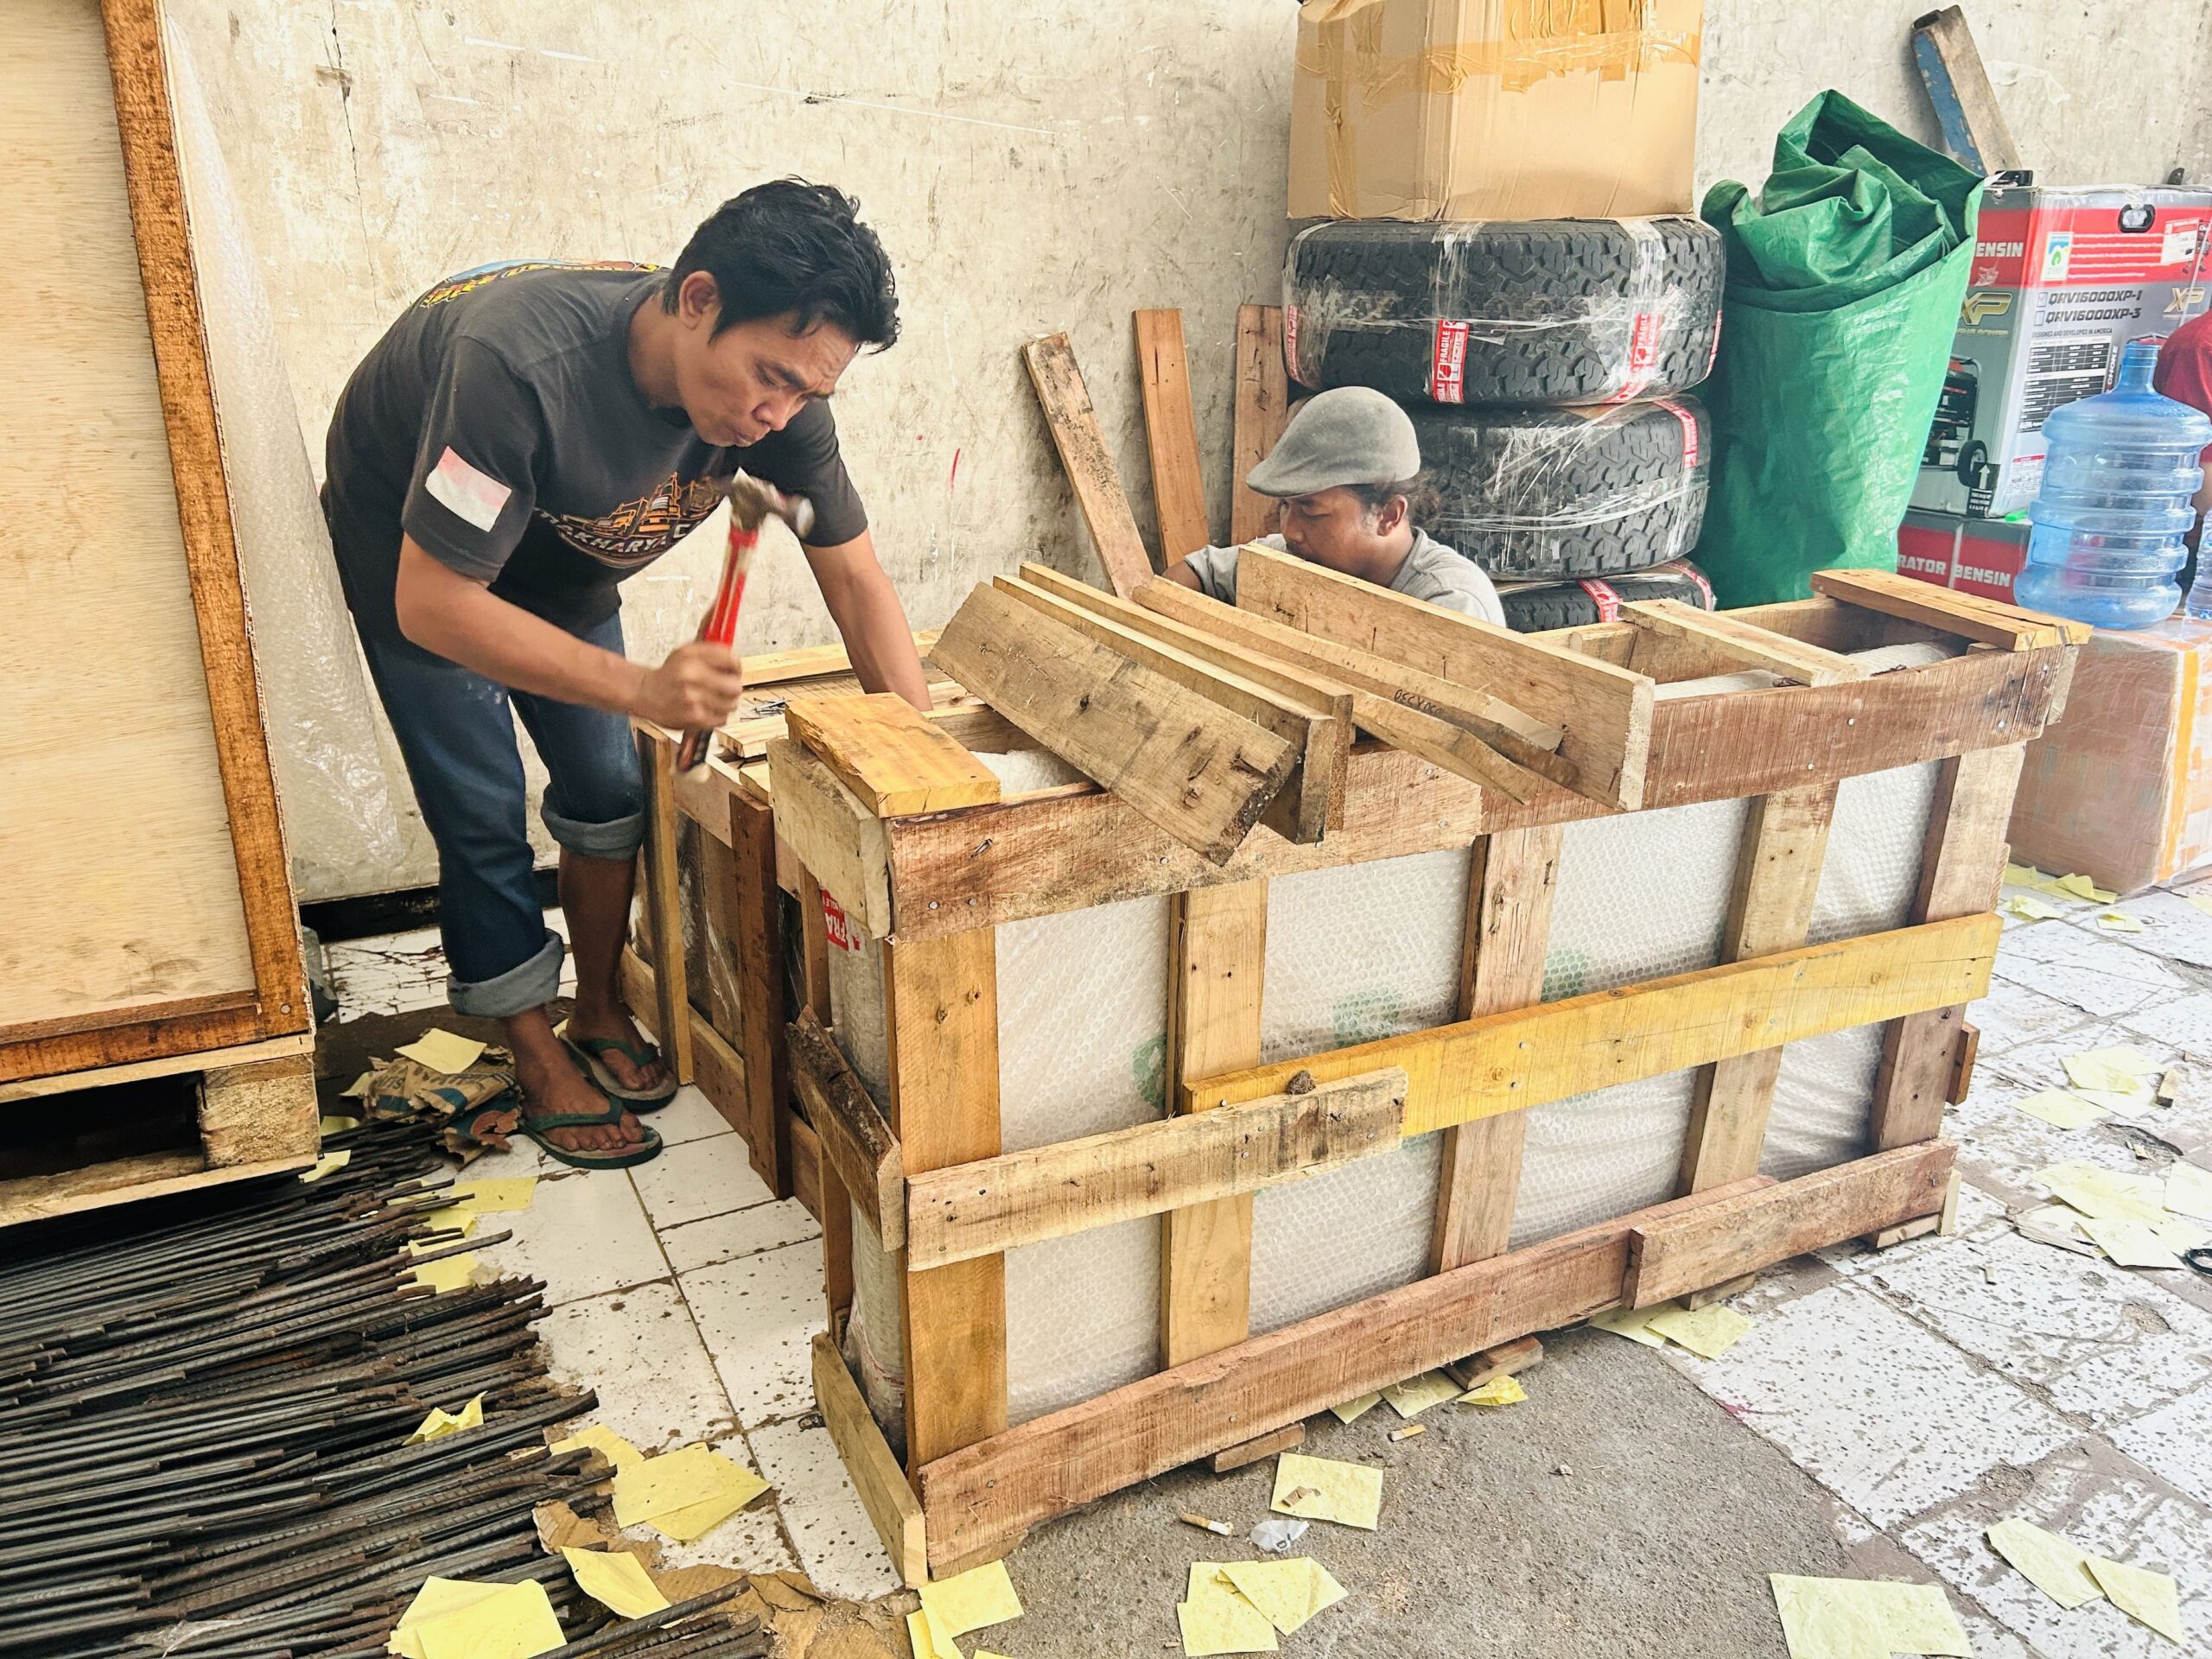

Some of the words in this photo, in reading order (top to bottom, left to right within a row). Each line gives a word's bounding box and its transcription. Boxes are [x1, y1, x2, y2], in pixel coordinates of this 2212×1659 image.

[1975, 242, 2024, 257] ENSIN
[2164, 287, 2205, 313] XP
[1439, 330, 1451, 363] FRAGILE
[1897, 554, 1947, 575] RATOR
[1955, 563, 2011, 588] BENSIN
[825, 912, 847, 943] FRA
